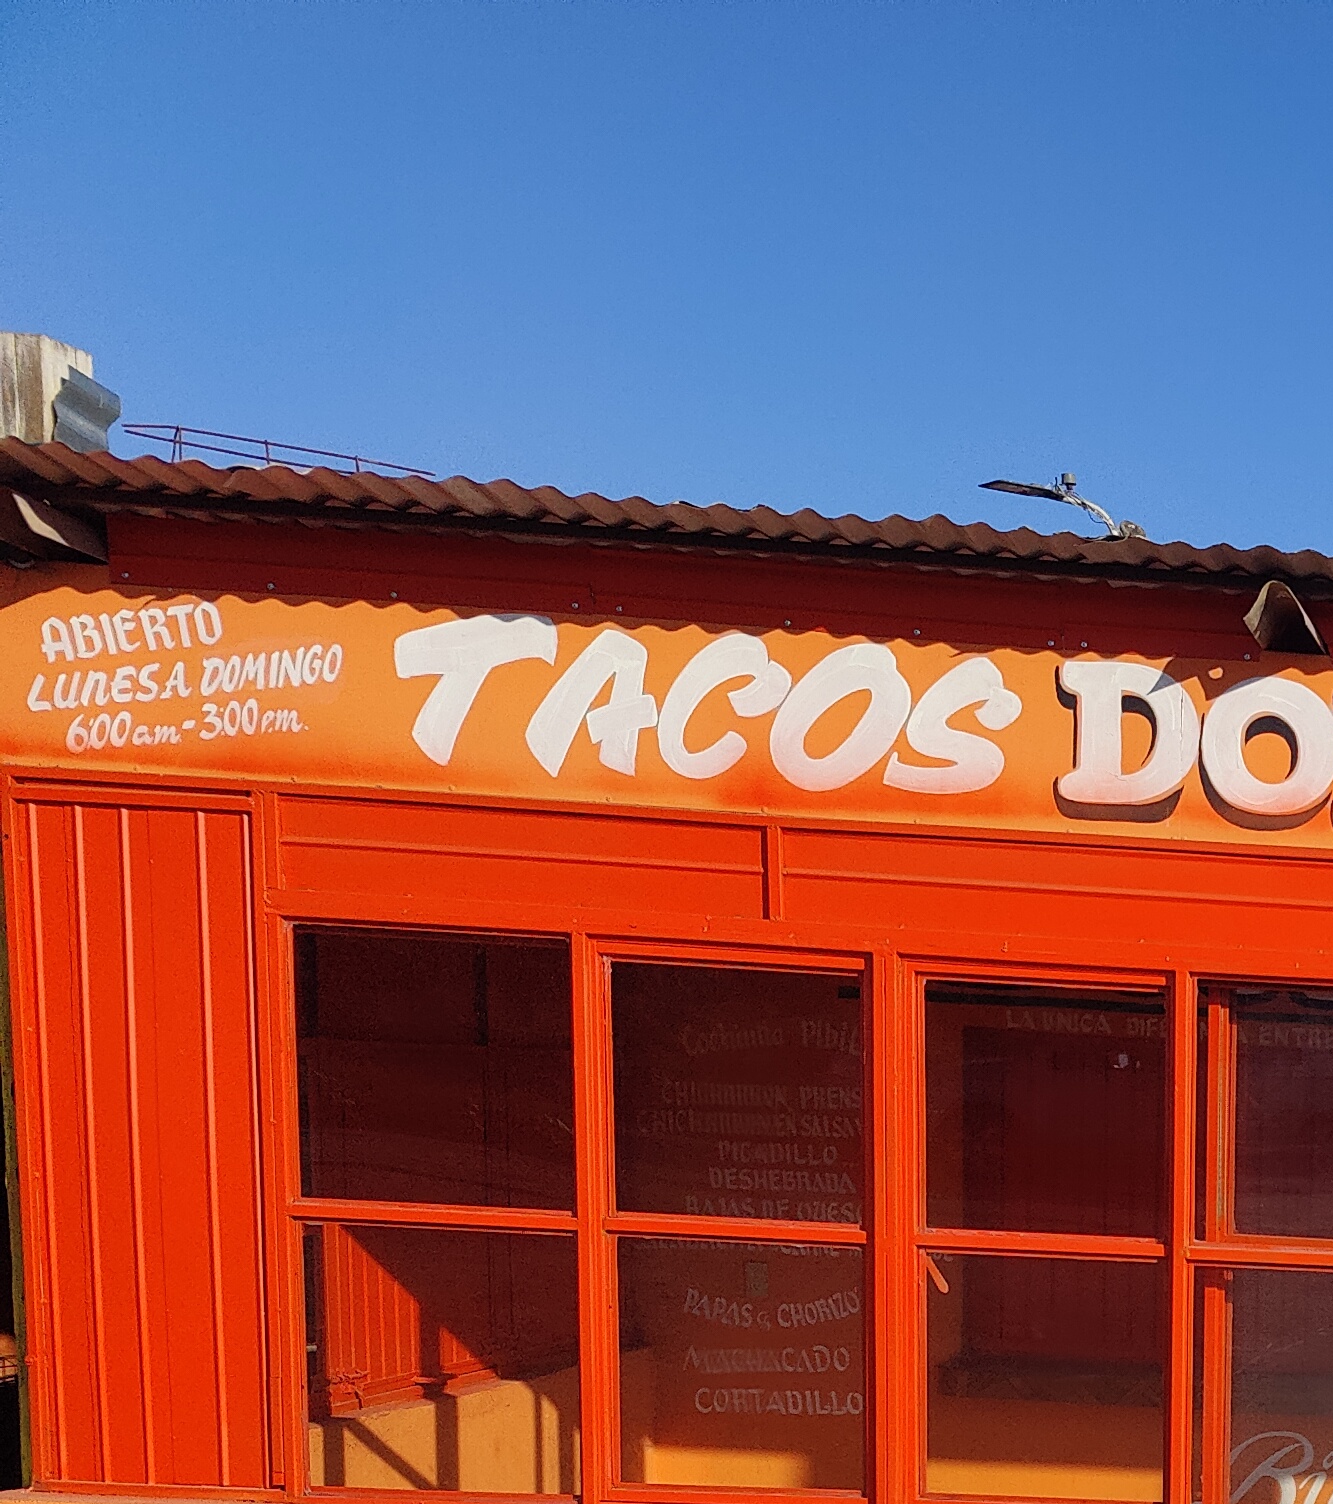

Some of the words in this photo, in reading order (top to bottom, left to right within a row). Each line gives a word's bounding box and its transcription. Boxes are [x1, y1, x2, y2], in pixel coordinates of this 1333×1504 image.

[41, 601, 222, 663] ABIERTO
[27, 663, 160, 711] LUNES
[200, 644, 343, 697] DOMINGO
[393, 613, 1022, 794] TACOS
[1006, 1009, 1036, 1031] LA
[1042, 1010, 1112, 1035] UNICA
[718, 1141, 838, 1165] PICADILLO
[709, 1167, 856, 1194] DESHEBRADA
[796, 1201, 862, 1222] QUES
[682, 1288, 753, 1328] PAPAS
[777, 1286, 860, 1328] CHORIZO
[682, 1344, 851, 1374] MACHACADO
[694, 1386, 863, 1416] CORTADILLO
